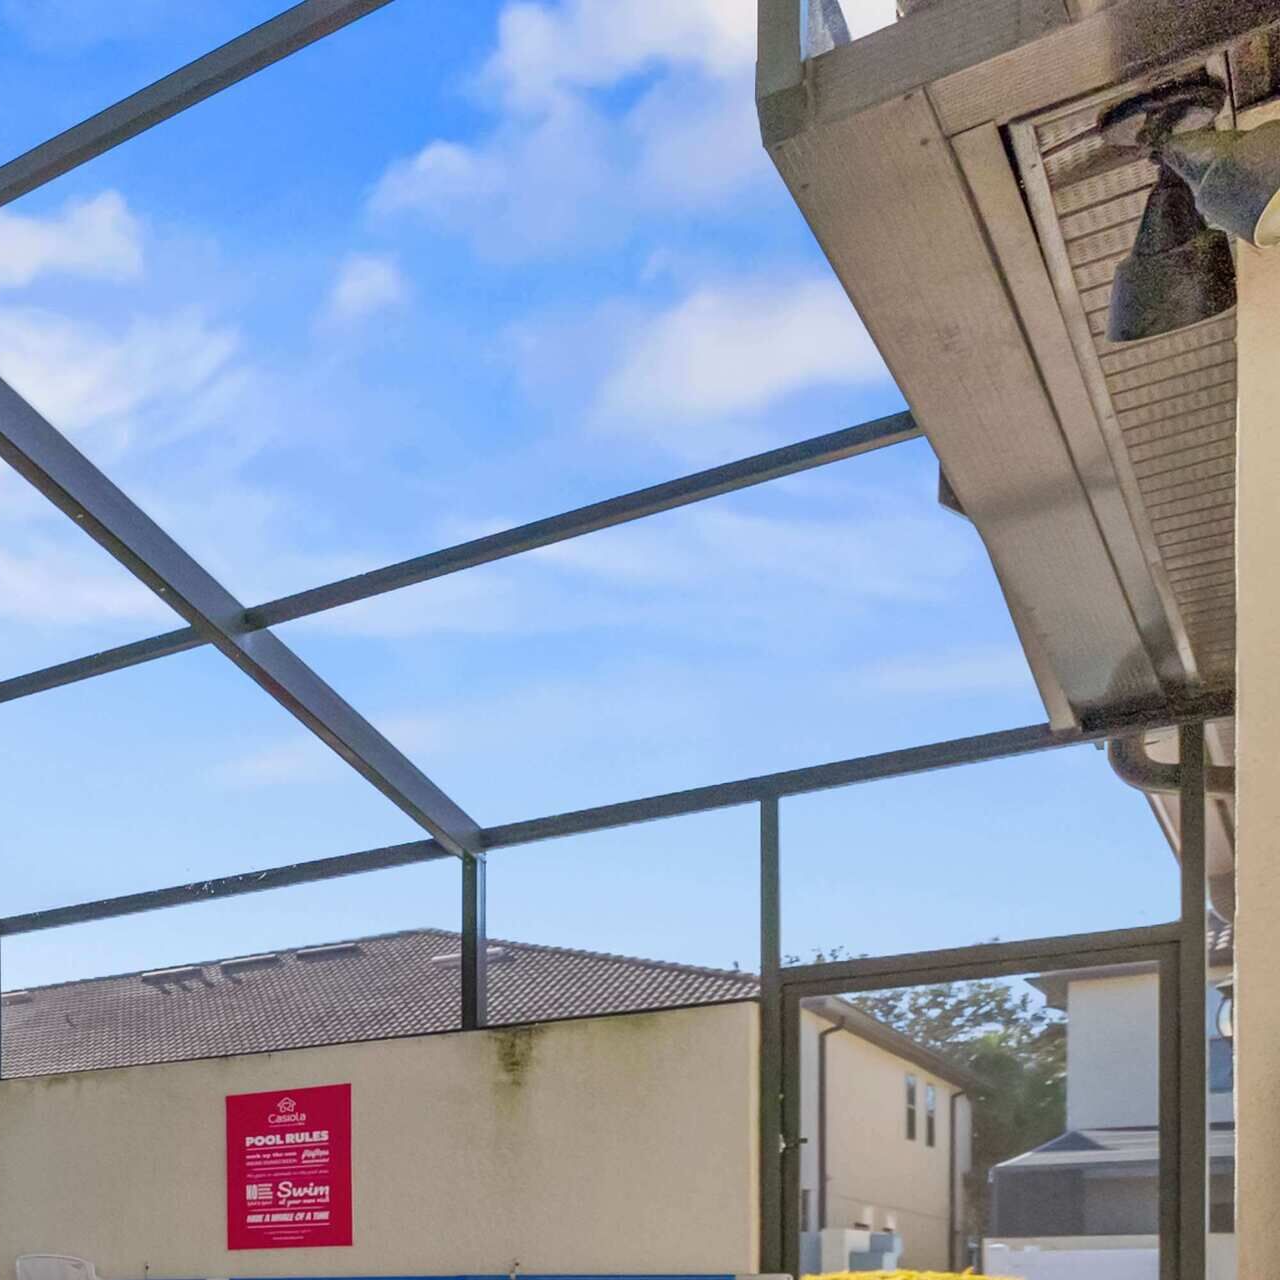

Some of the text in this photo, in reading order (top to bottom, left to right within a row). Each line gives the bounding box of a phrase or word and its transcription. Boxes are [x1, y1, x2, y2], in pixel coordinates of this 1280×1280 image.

[268, 1112, 306, 1124] Casiola
[245, 1130, 329, 1147] POOL RULES
[277, 1181, 330, 1200] Swim
